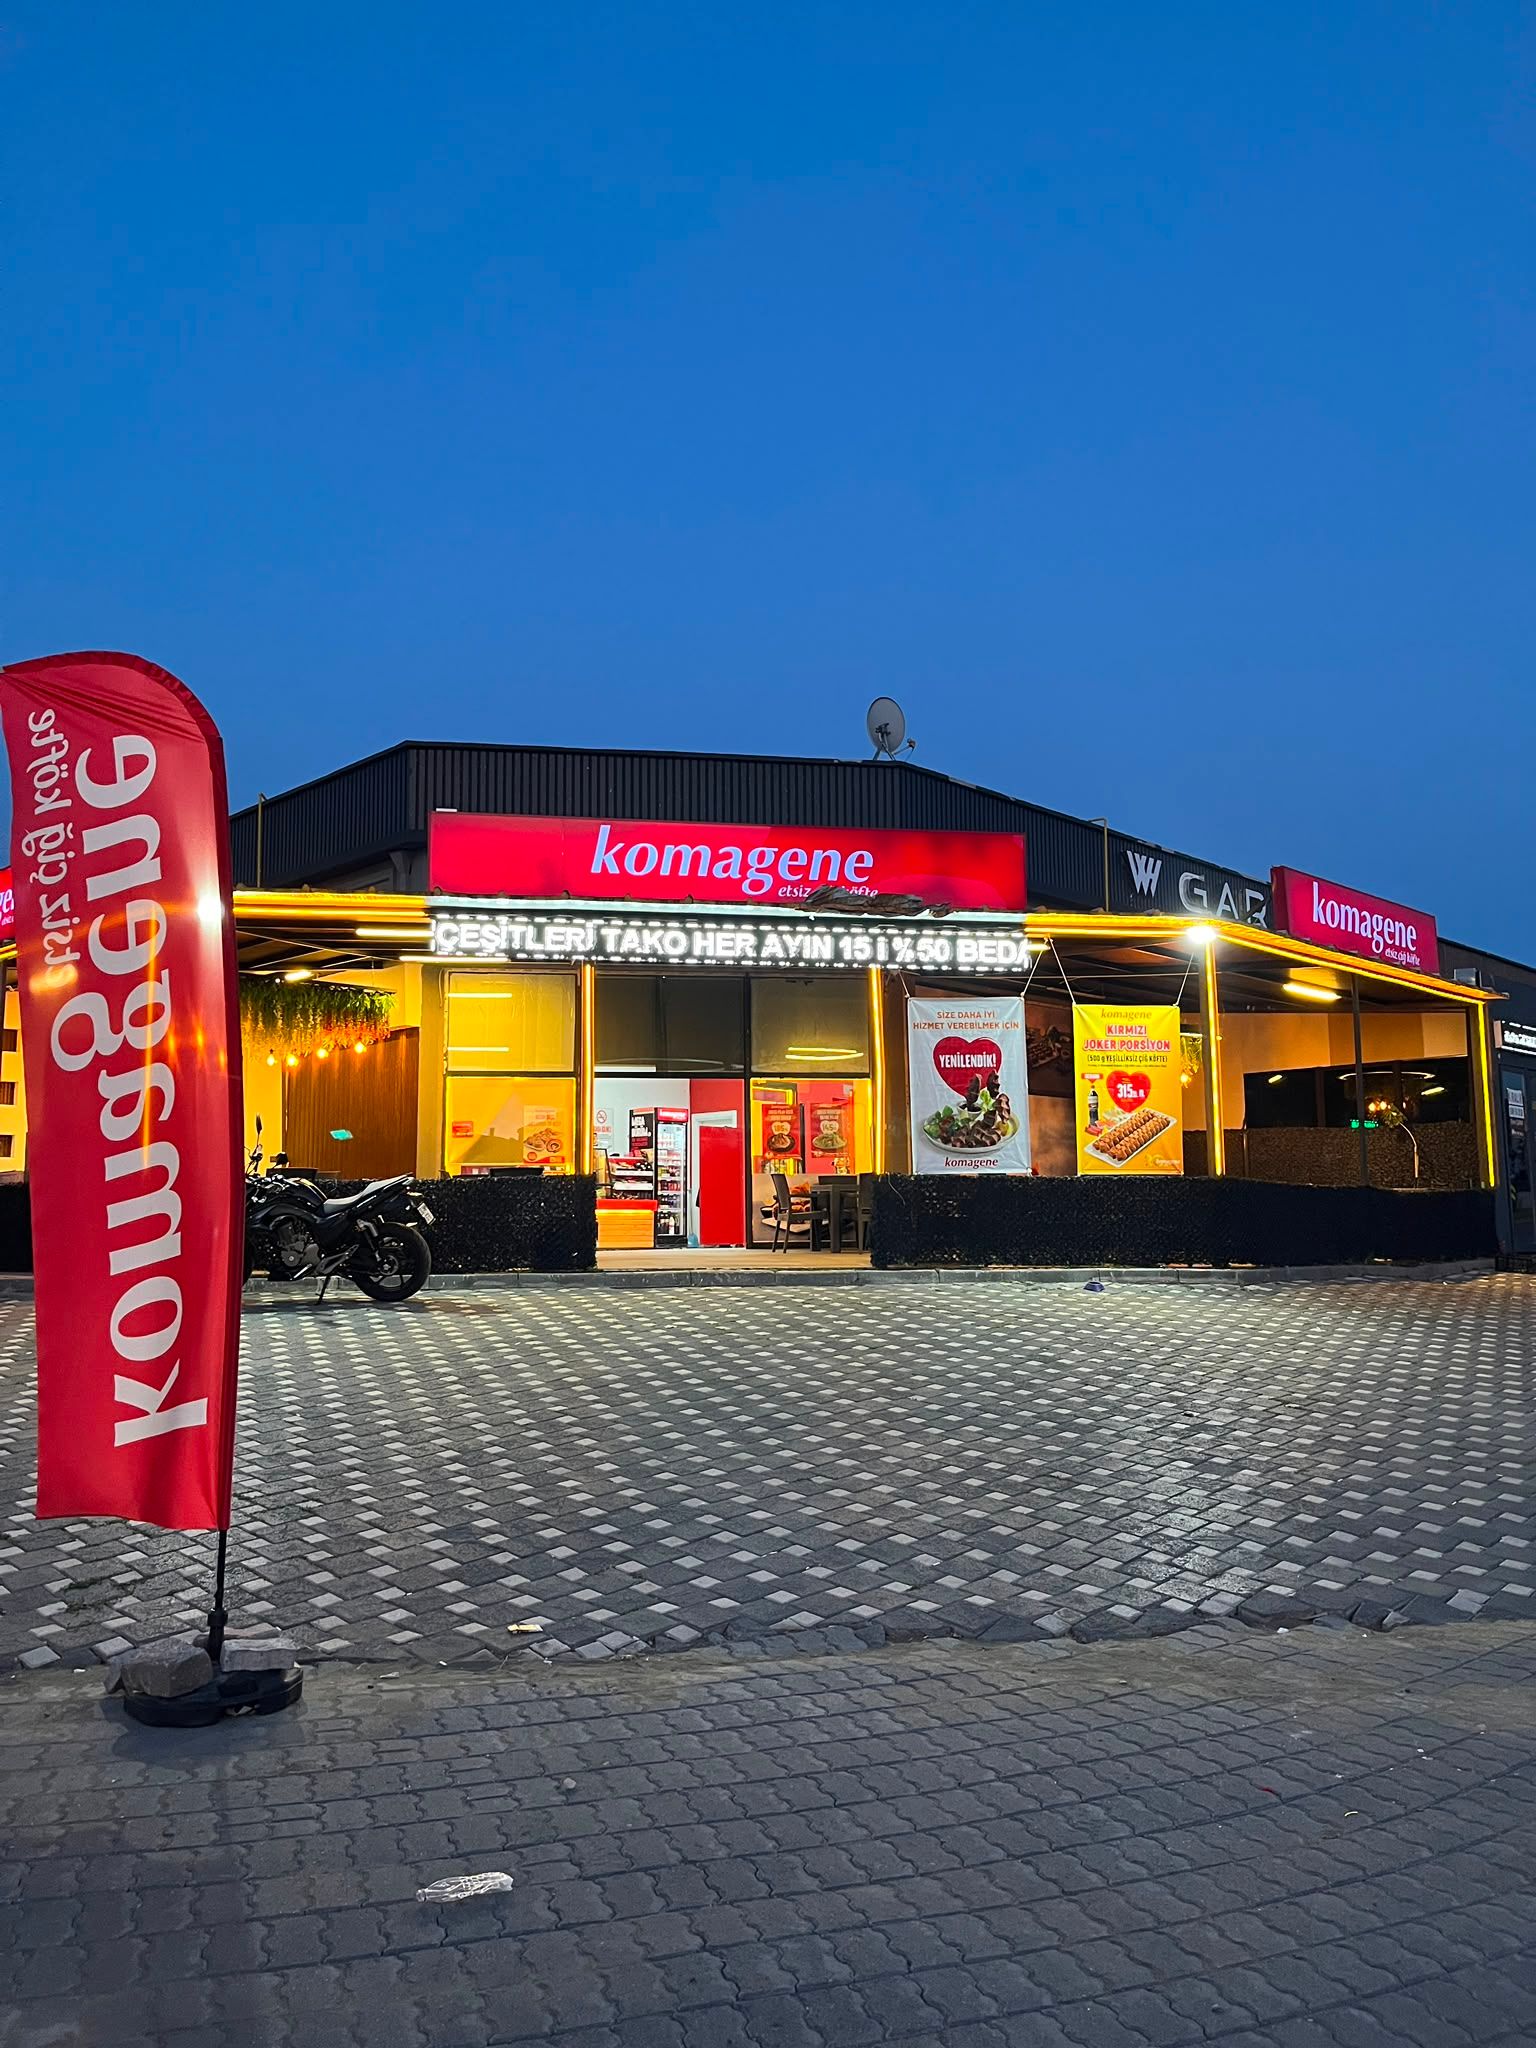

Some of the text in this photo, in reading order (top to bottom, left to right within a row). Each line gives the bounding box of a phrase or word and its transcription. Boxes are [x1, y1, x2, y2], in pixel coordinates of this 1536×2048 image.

[590, 825, 874, 896] komagene
[778, 884, 879, 897] etsiz öfte
[1312, 881, 1417, 954] komagene
[600, 927, 688, 955] TAKO
[693, 931, 757, 957] HER
[760, 933, 833, 960] AYIN
[839, 935, 872, 961] 15
[891, 937, 952, 964] %50
[957, 1011, 982, 1019] DAHA
[1101, 1008, 1152, 1020] komagene
[1106, 1025, 1147, 1036] KIRMIZI
[1083, 1038, 1171, 1051] JOKER PORSİYON
[939, 1051, 997, 1068] YENİLENDİK!
[1117, 1083, 1134, 1099] 315
[945, 1156, 999, 1169] komagene
